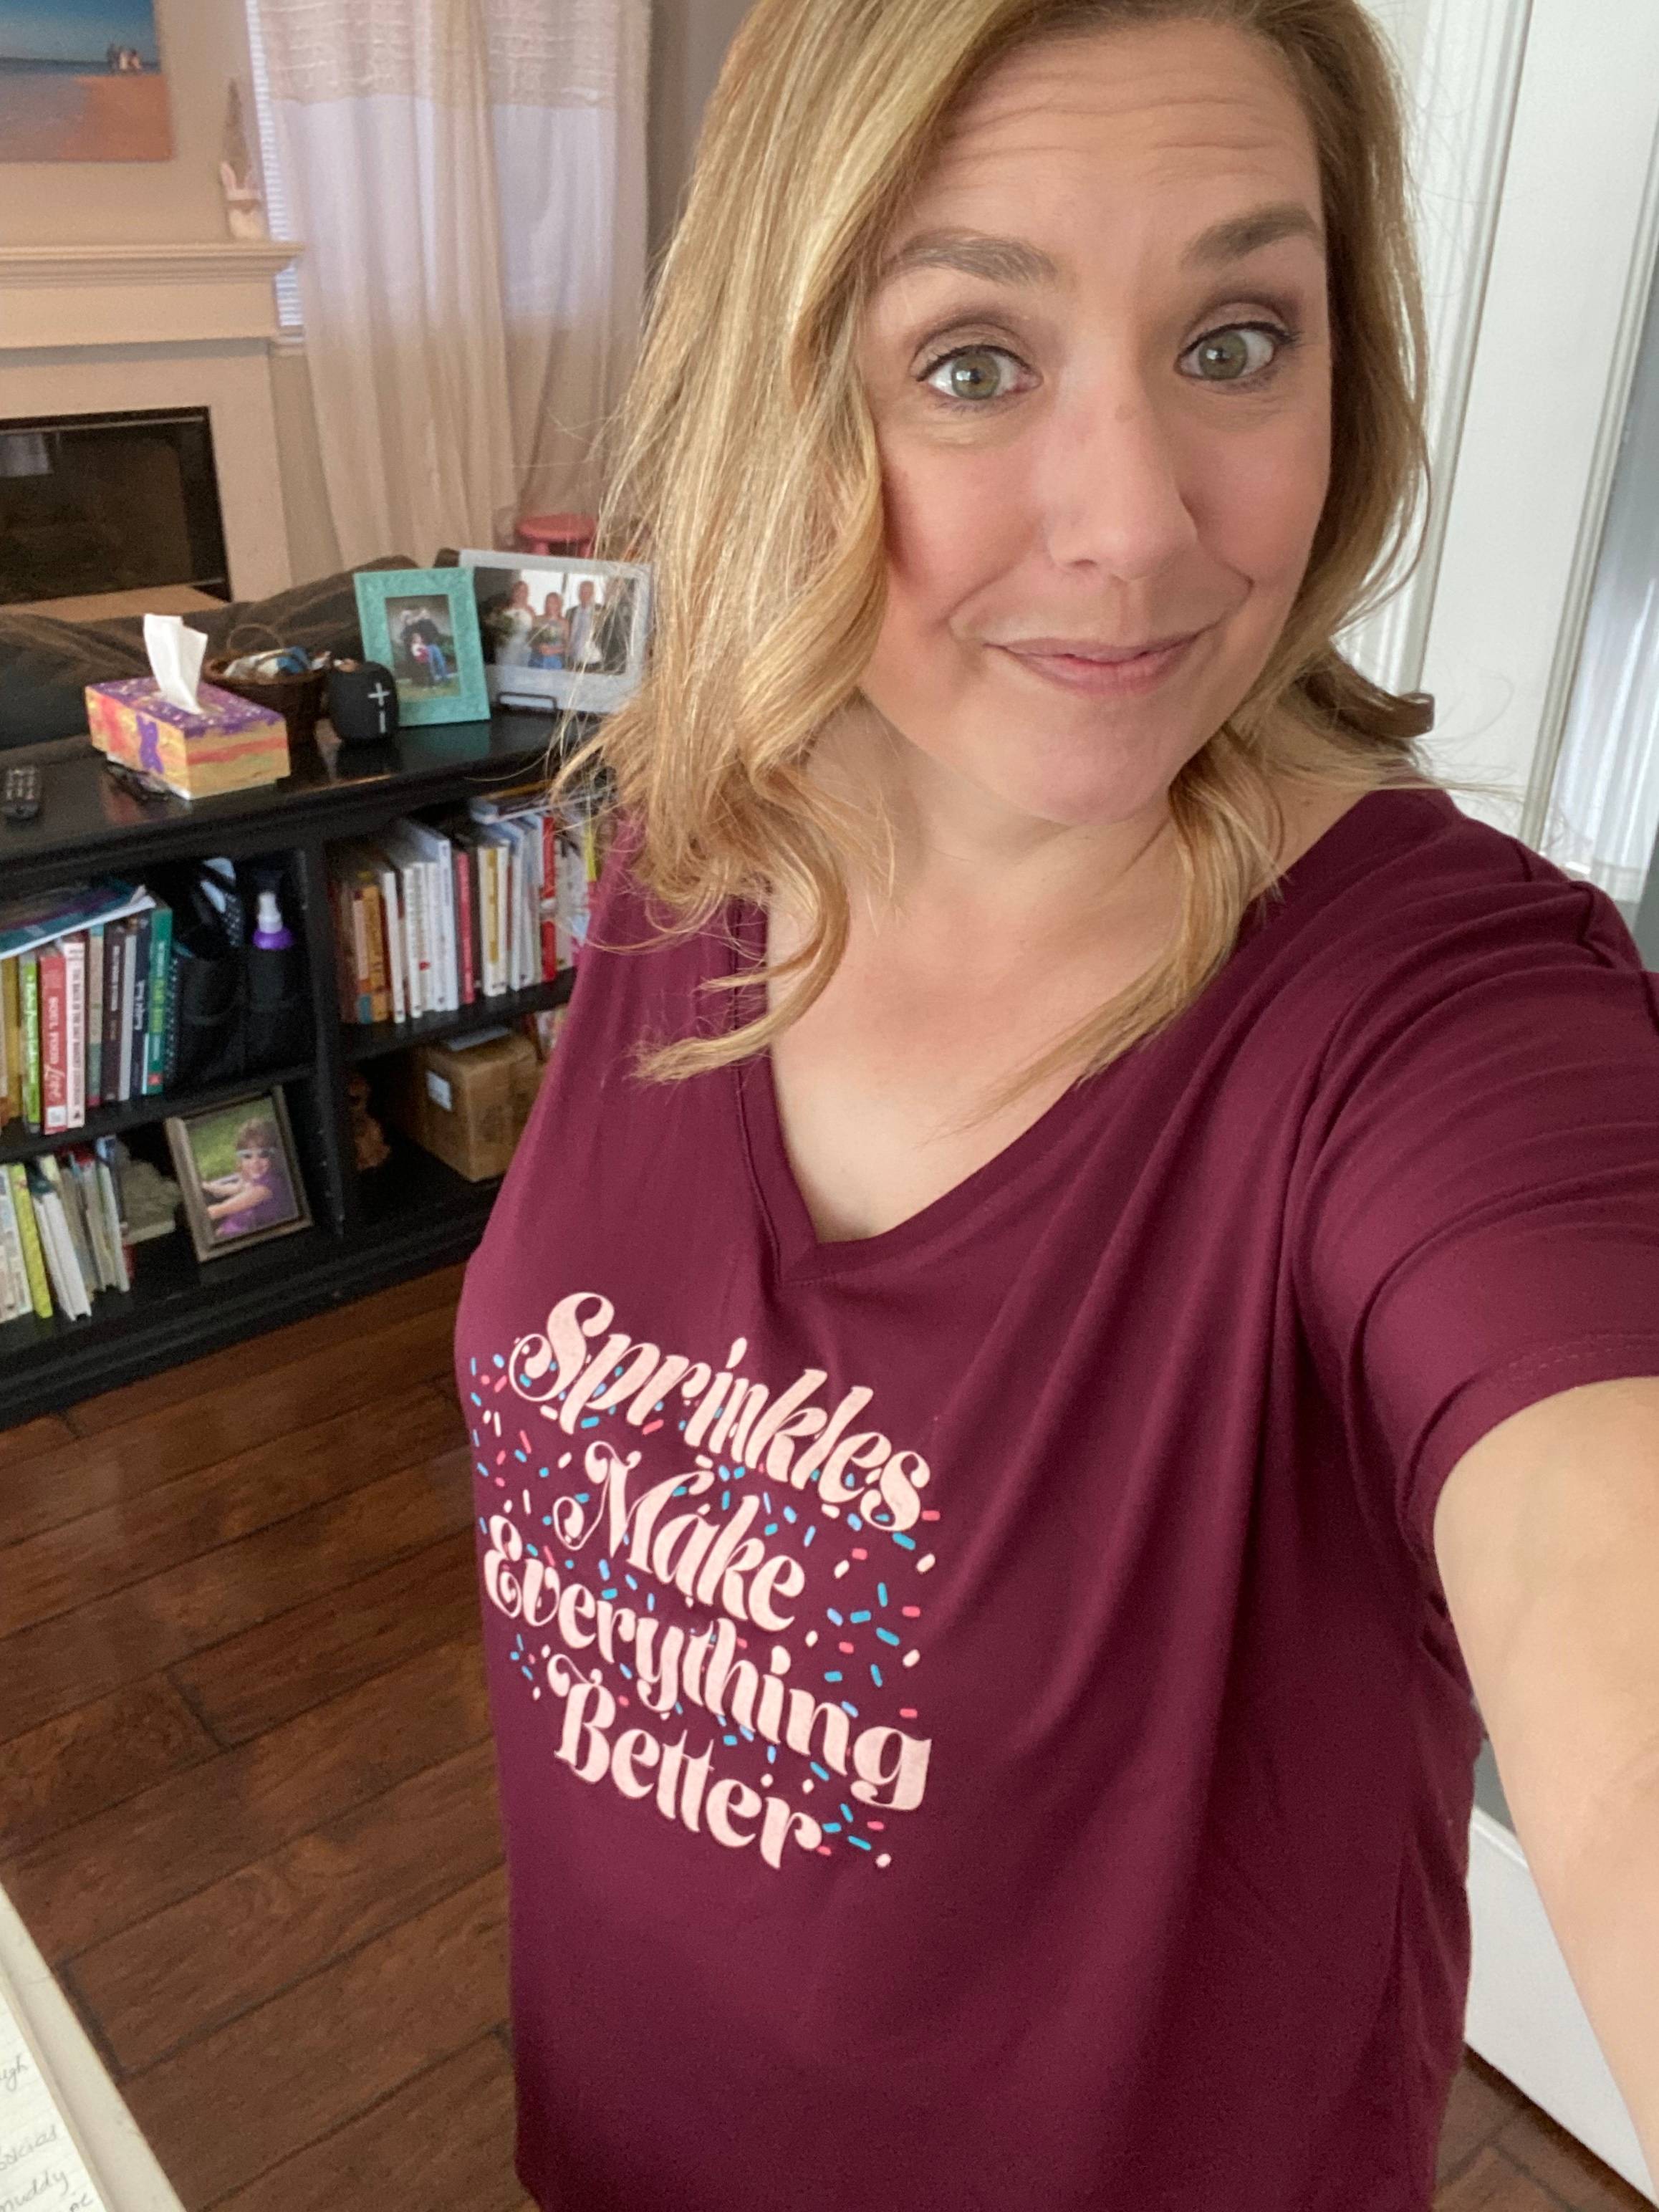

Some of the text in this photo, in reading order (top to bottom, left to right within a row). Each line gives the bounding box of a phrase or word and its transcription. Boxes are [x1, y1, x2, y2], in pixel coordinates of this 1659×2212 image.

[507, 1292, 932, 1533] Sprinkles
[552, 1440, 806, 1632] Make
[483, 1514, 933, 1811] Everything
[547, 1653, 823, 1869] Better
